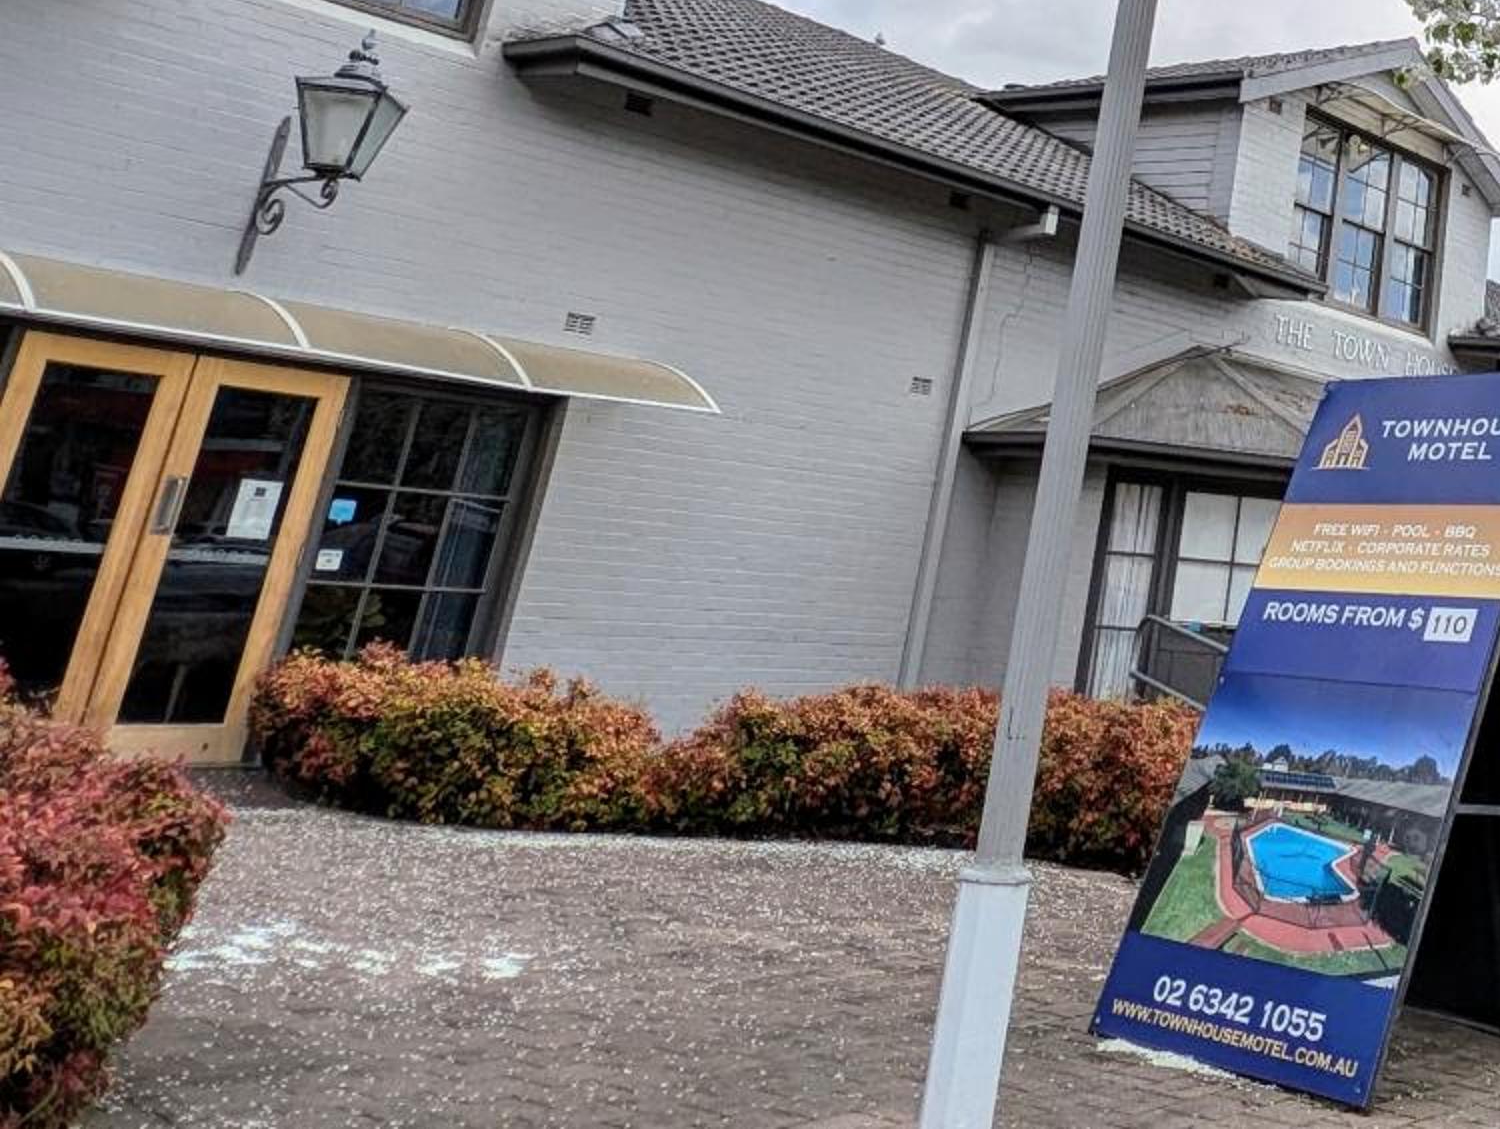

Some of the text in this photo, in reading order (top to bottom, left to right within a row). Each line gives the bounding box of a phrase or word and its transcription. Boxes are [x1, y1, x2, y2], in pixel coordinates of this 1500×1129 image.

[1274, 313, 1313, 350] THE
[1332, 329, 1391, 370] TOWN
[1408, 442, 1492, 461] MOTEL
[1313, 523, 1477, 539] FREE WIFI POOL BBQ
[1291, 539, 1491, 558] NETFLIX CORPORATE RATES
[1268, 556, 1315, 570] GROUP
[1315, 558, 1385, 573] BOOKINGS
[1384, 560, 1419, 574] AND
[1263, 602, 1338, 625] ROOMS
[1341, 605, 1405, 628] FROM
[1153, 975, 1327, 1042] 02 6342 1055
[1112, 998, 1358, 1078] WWW.TOWNHOUSEMOTEL.COM.AU
